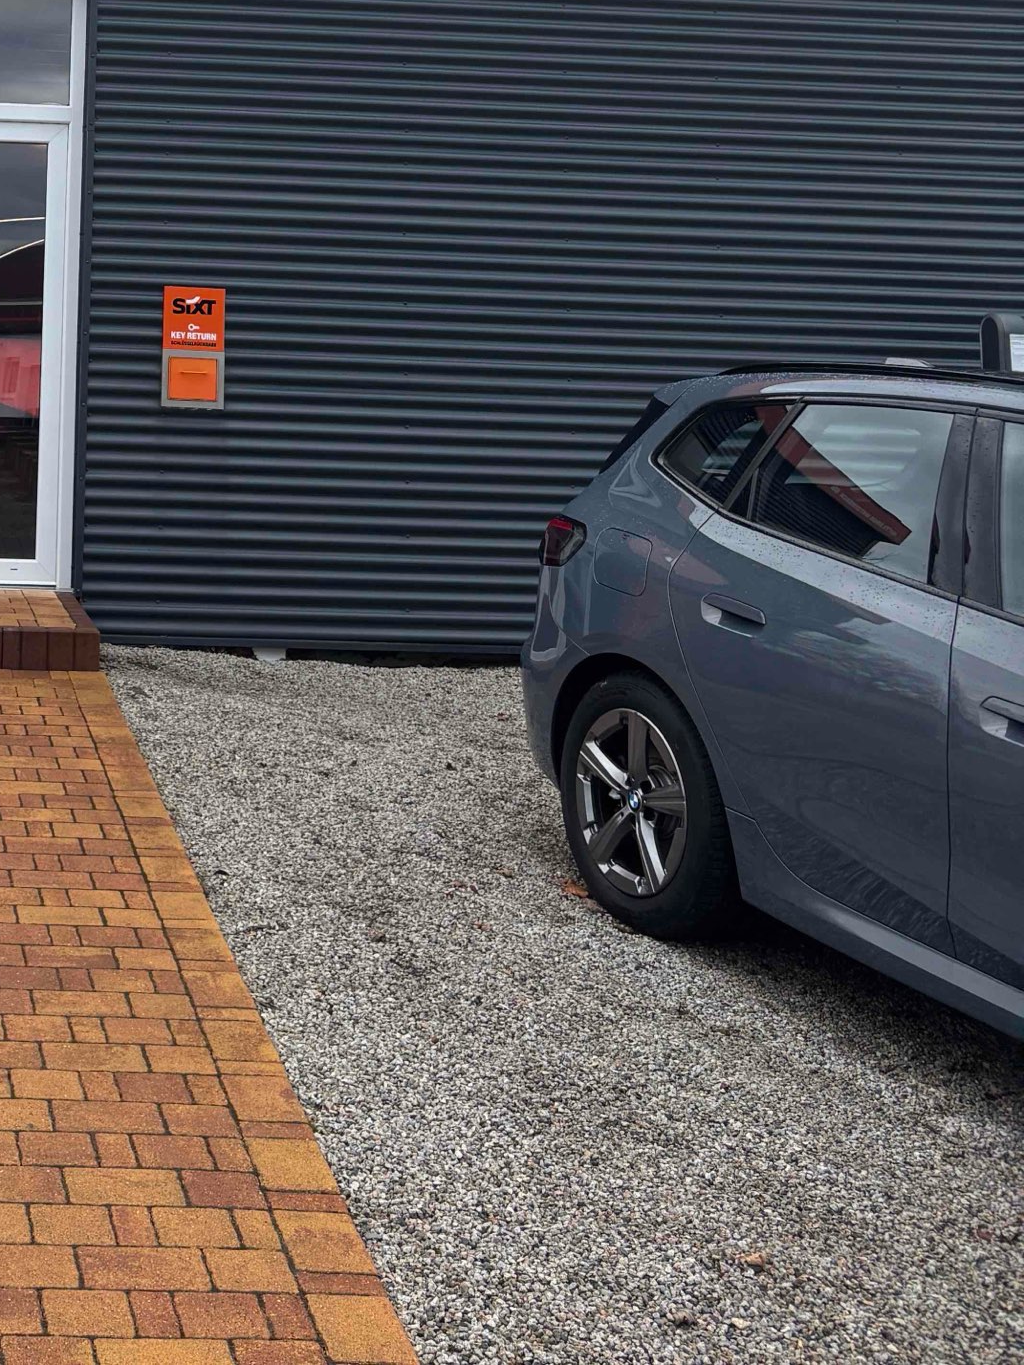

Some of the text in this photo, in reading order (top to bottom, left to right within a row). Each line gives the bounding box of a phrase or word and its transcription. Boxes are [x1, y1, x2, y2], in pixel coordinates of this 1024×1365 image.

[172, 296, 217, 316] SIXT
[170, 331, 217, 341] KEY RETURN
